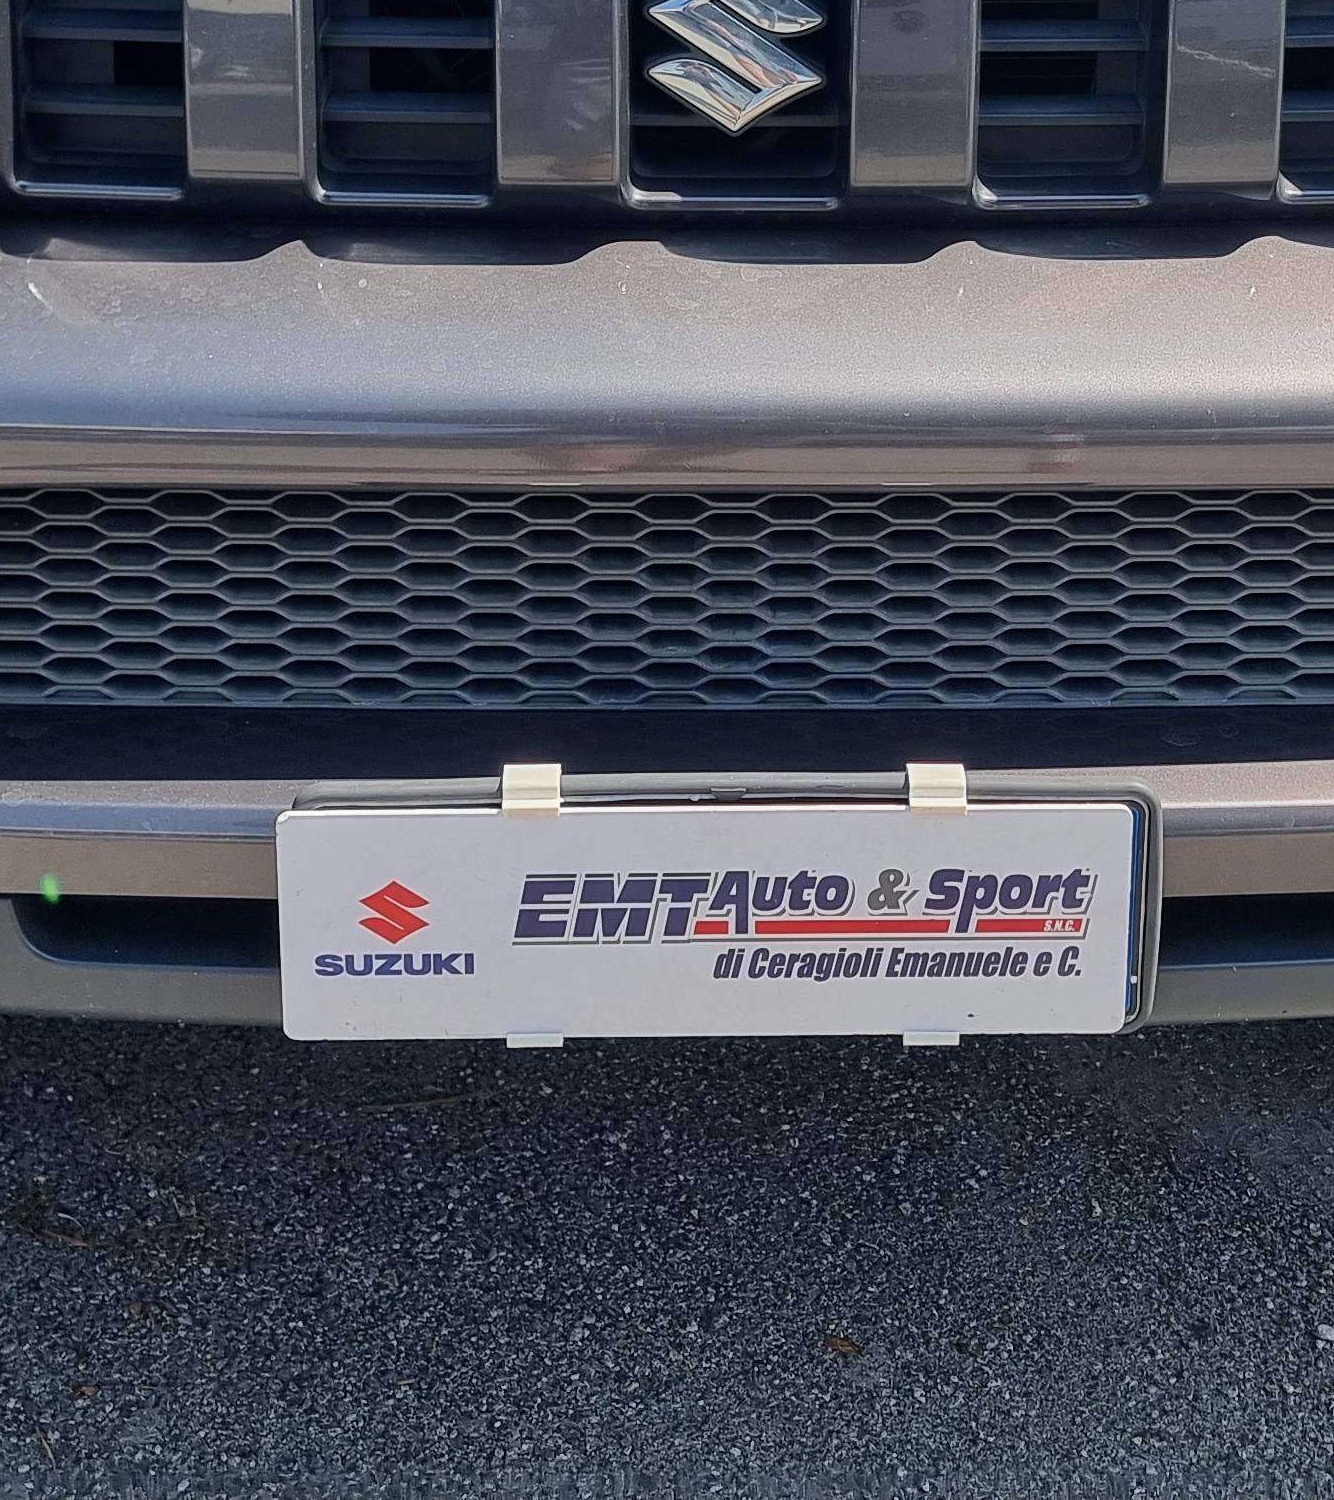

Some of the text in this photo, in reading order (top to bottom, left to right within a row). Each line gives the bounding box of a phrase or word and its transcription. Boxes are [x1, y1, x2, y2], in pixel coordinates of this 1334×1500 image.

[708, 870, 855, 935] Auto
[867, 868, 919, 916] &
[923, 868, 1097, 933] Sport
[1042, 919, 1076, 932] S.N.C.
[314, 953, 474, 976] SUZUKI
[713, 945, 1081, 982] di Ceragioli Emanuele e C.
